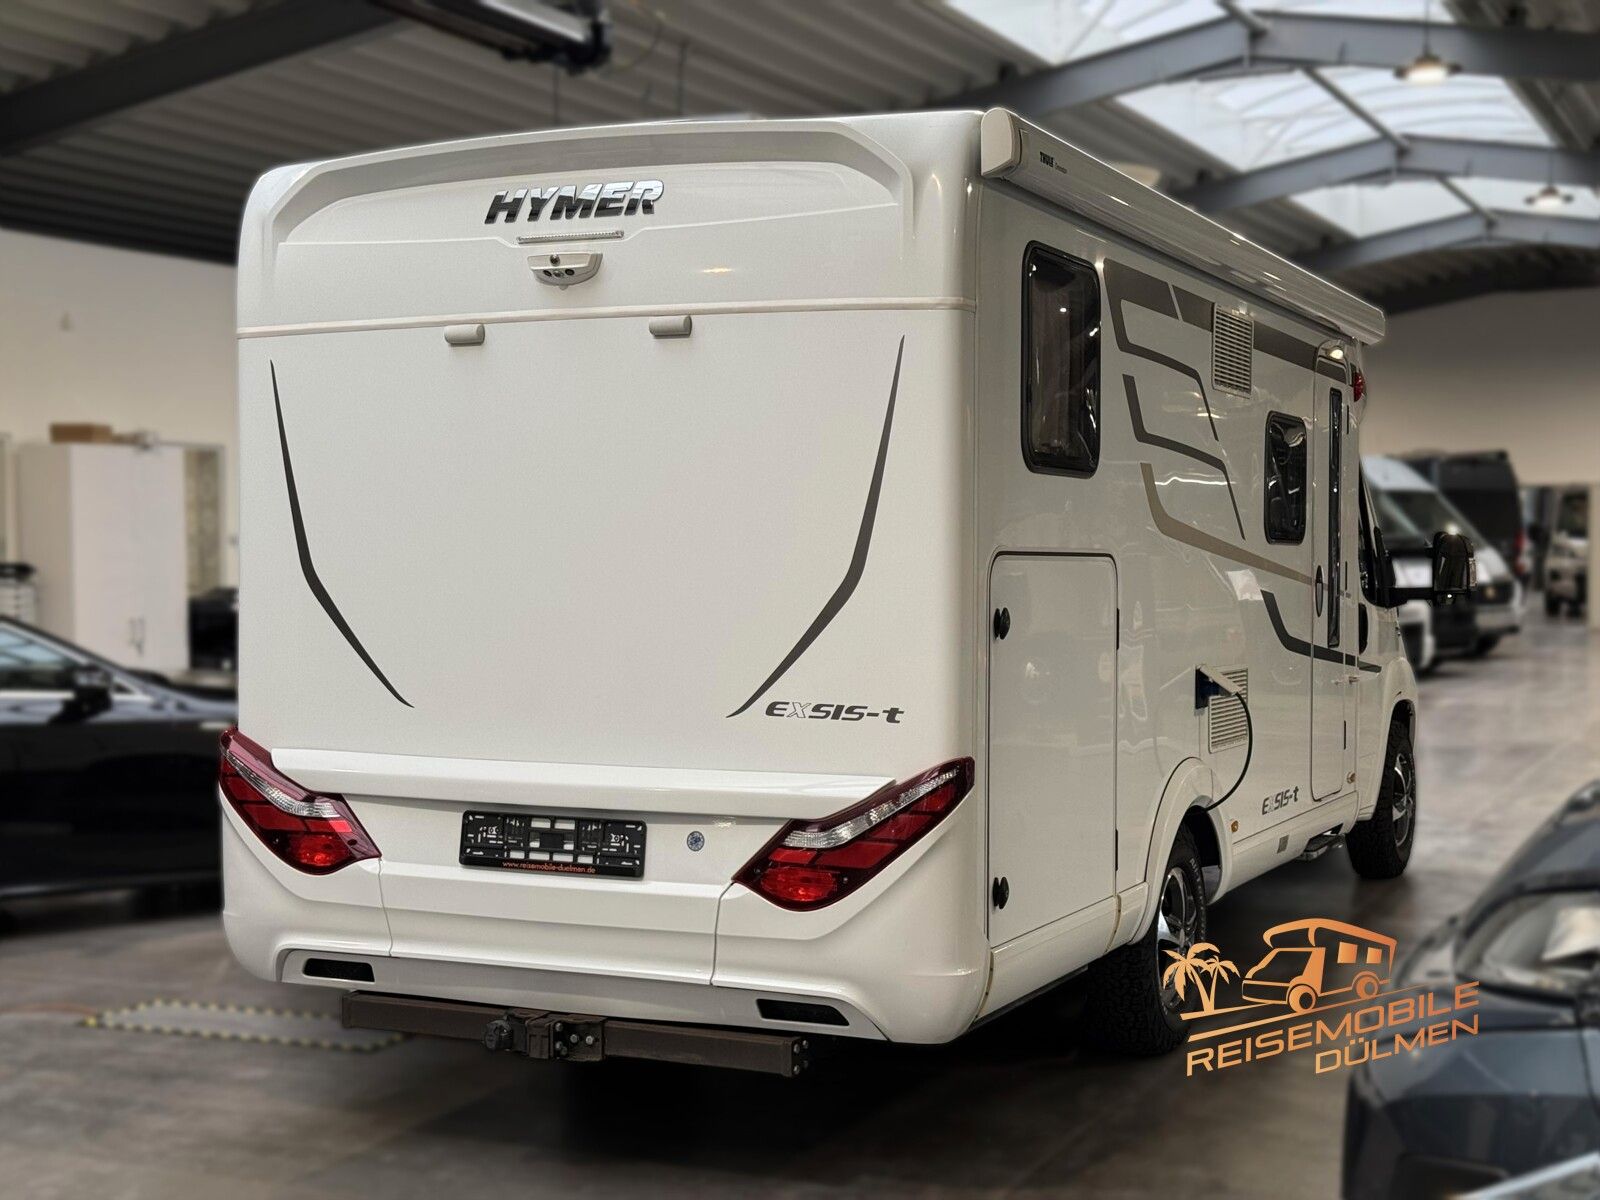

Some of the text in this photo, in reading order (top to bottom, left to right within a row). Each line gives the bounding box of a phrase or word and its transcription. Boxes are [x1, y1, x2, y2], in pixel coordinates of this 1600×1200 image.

[484, 179, 664, 224] HYMER
[765, 701, 905, 724] EXSIS-t
[502, 861, 596, 874] www.reisemobile-duelmen.de
